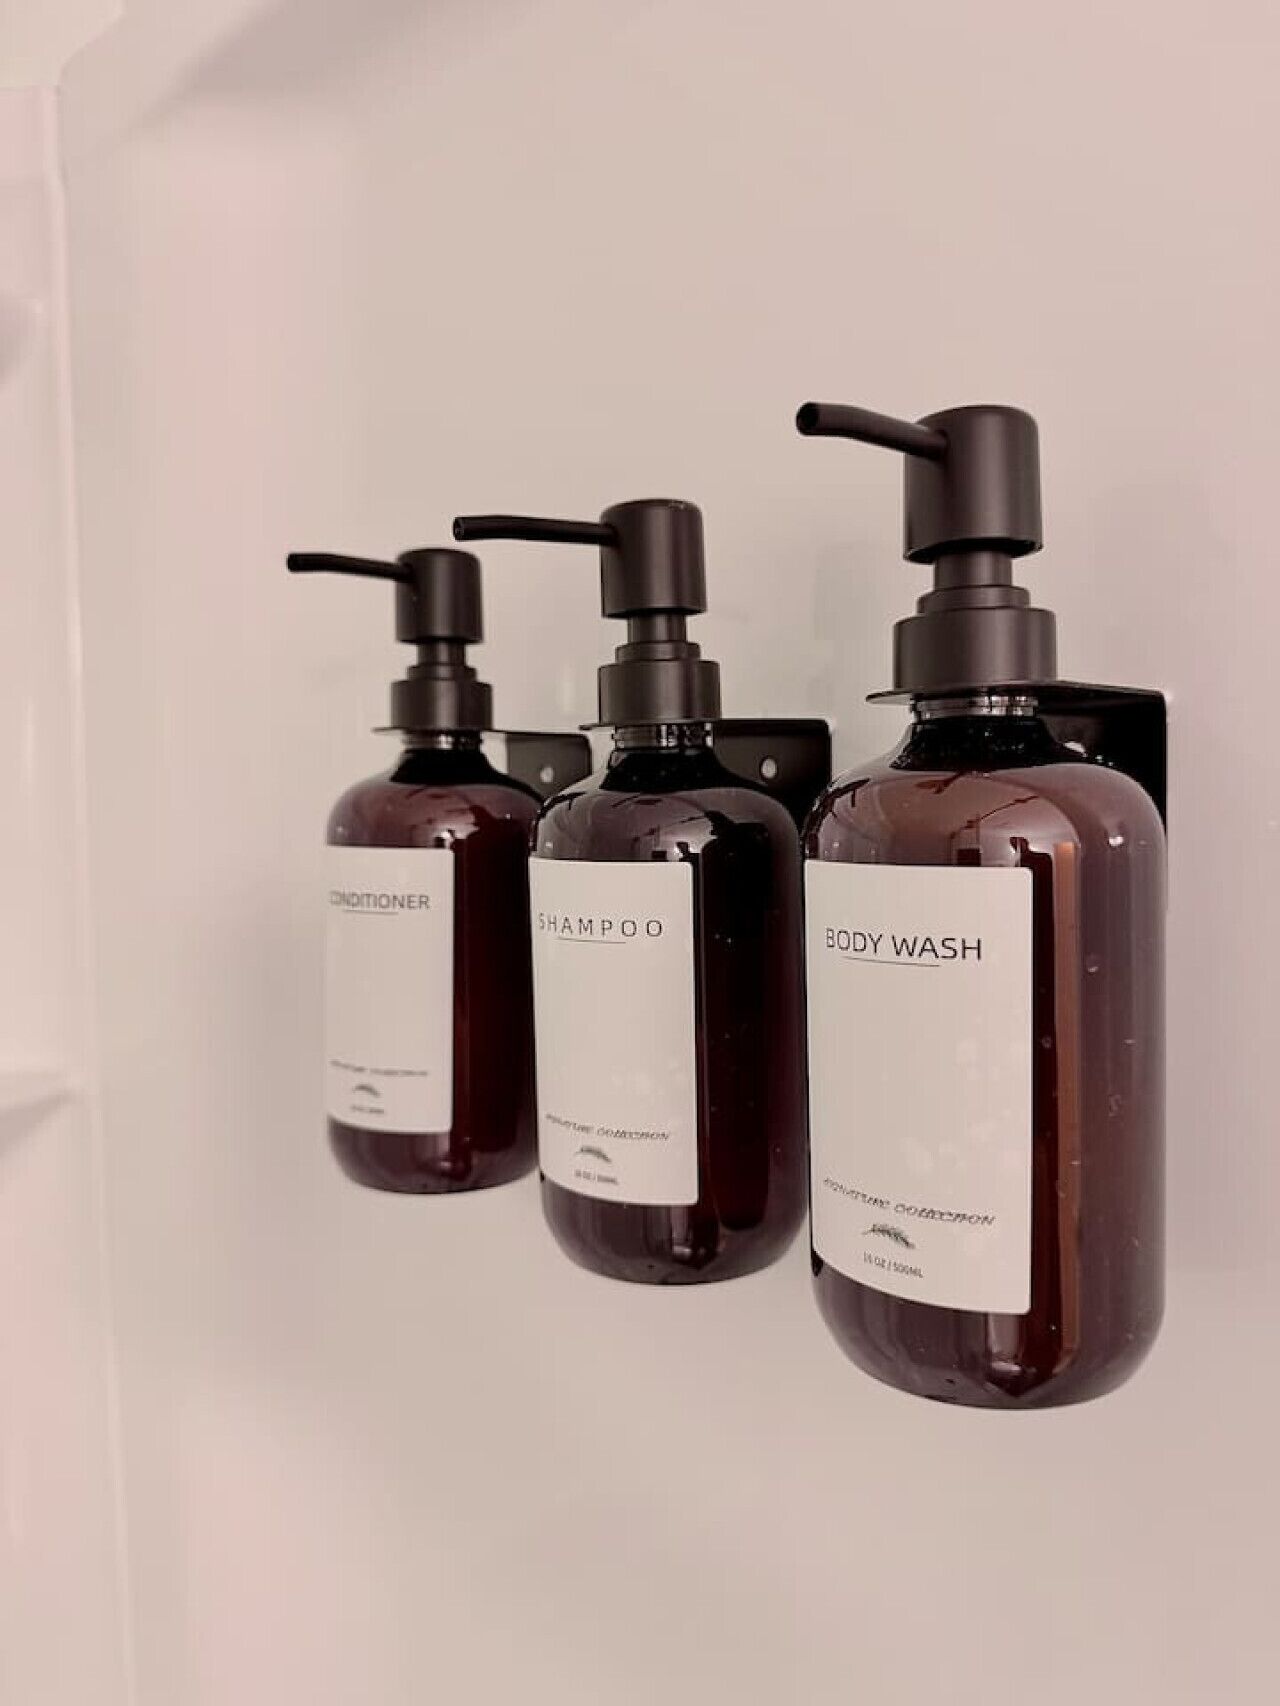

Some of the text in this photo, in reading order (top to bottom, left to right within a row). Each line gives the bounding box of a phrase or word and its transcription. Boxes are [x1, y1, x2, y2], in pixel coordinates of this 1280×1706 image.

[539, 912, 662, 937] SHAMPOO
[826, 927, 982, 961] BODY WASH
